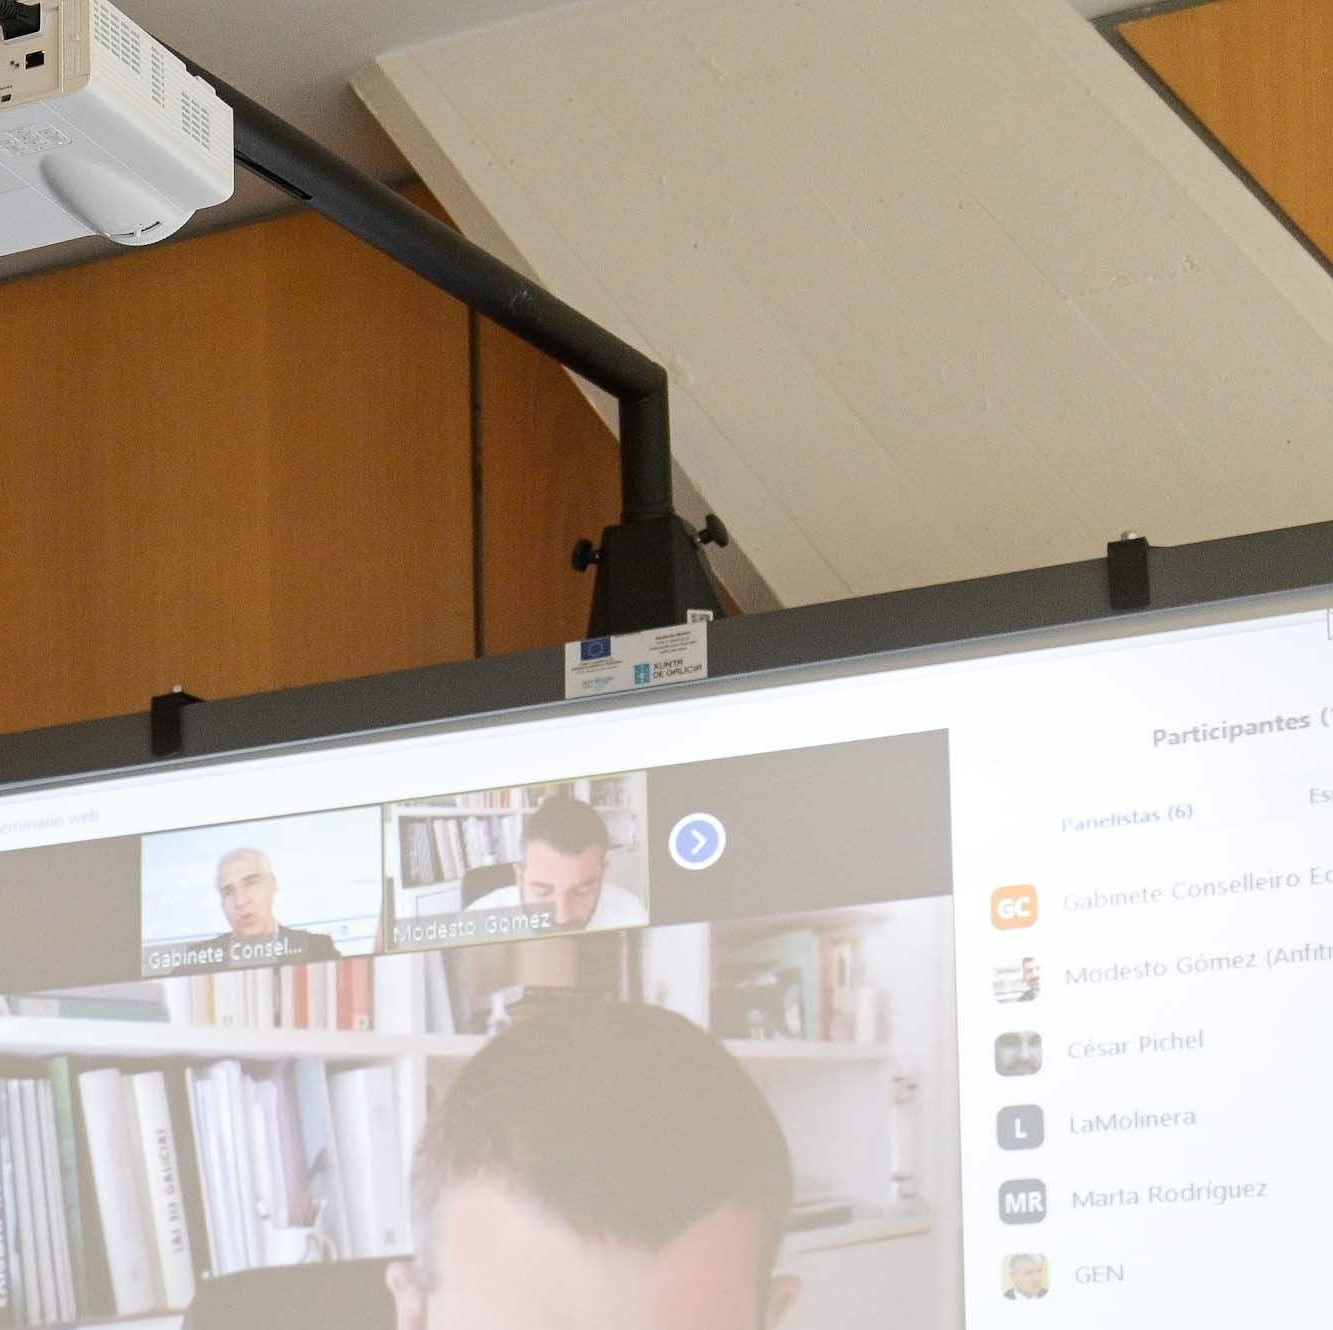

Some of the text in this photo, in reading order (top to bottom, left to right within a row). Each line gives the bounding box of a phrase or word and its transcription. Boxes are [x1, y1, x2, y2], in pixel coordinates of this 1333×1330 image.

[1152, 711, 1311, 748] Participantes
[68, 808, 100, 824] web
[1061, 803, 1194, 832] Panelistas (6)
[1063, 884, 1162, 912] Gabinete
[1172, 872, 1300, 900] Conselleiro
[997, 898, 1031, 920] GC
[393, 919, 477, 943] Modesto
[148, 945, 223, 970] Gabinete
[1065, 957, 1167, 986] Modesto
[1068, 1030, 1203, 1060] César Pichel
[1015, 1119, 1028, 1139] L
[1070, 1109, 1197, 1135] LaMolinera
[1005, 1191, 1044, 1214] MR
[1073, 1188, 1139, 1209] Marta
[1075, 1265, 1125, 1285] GEN
